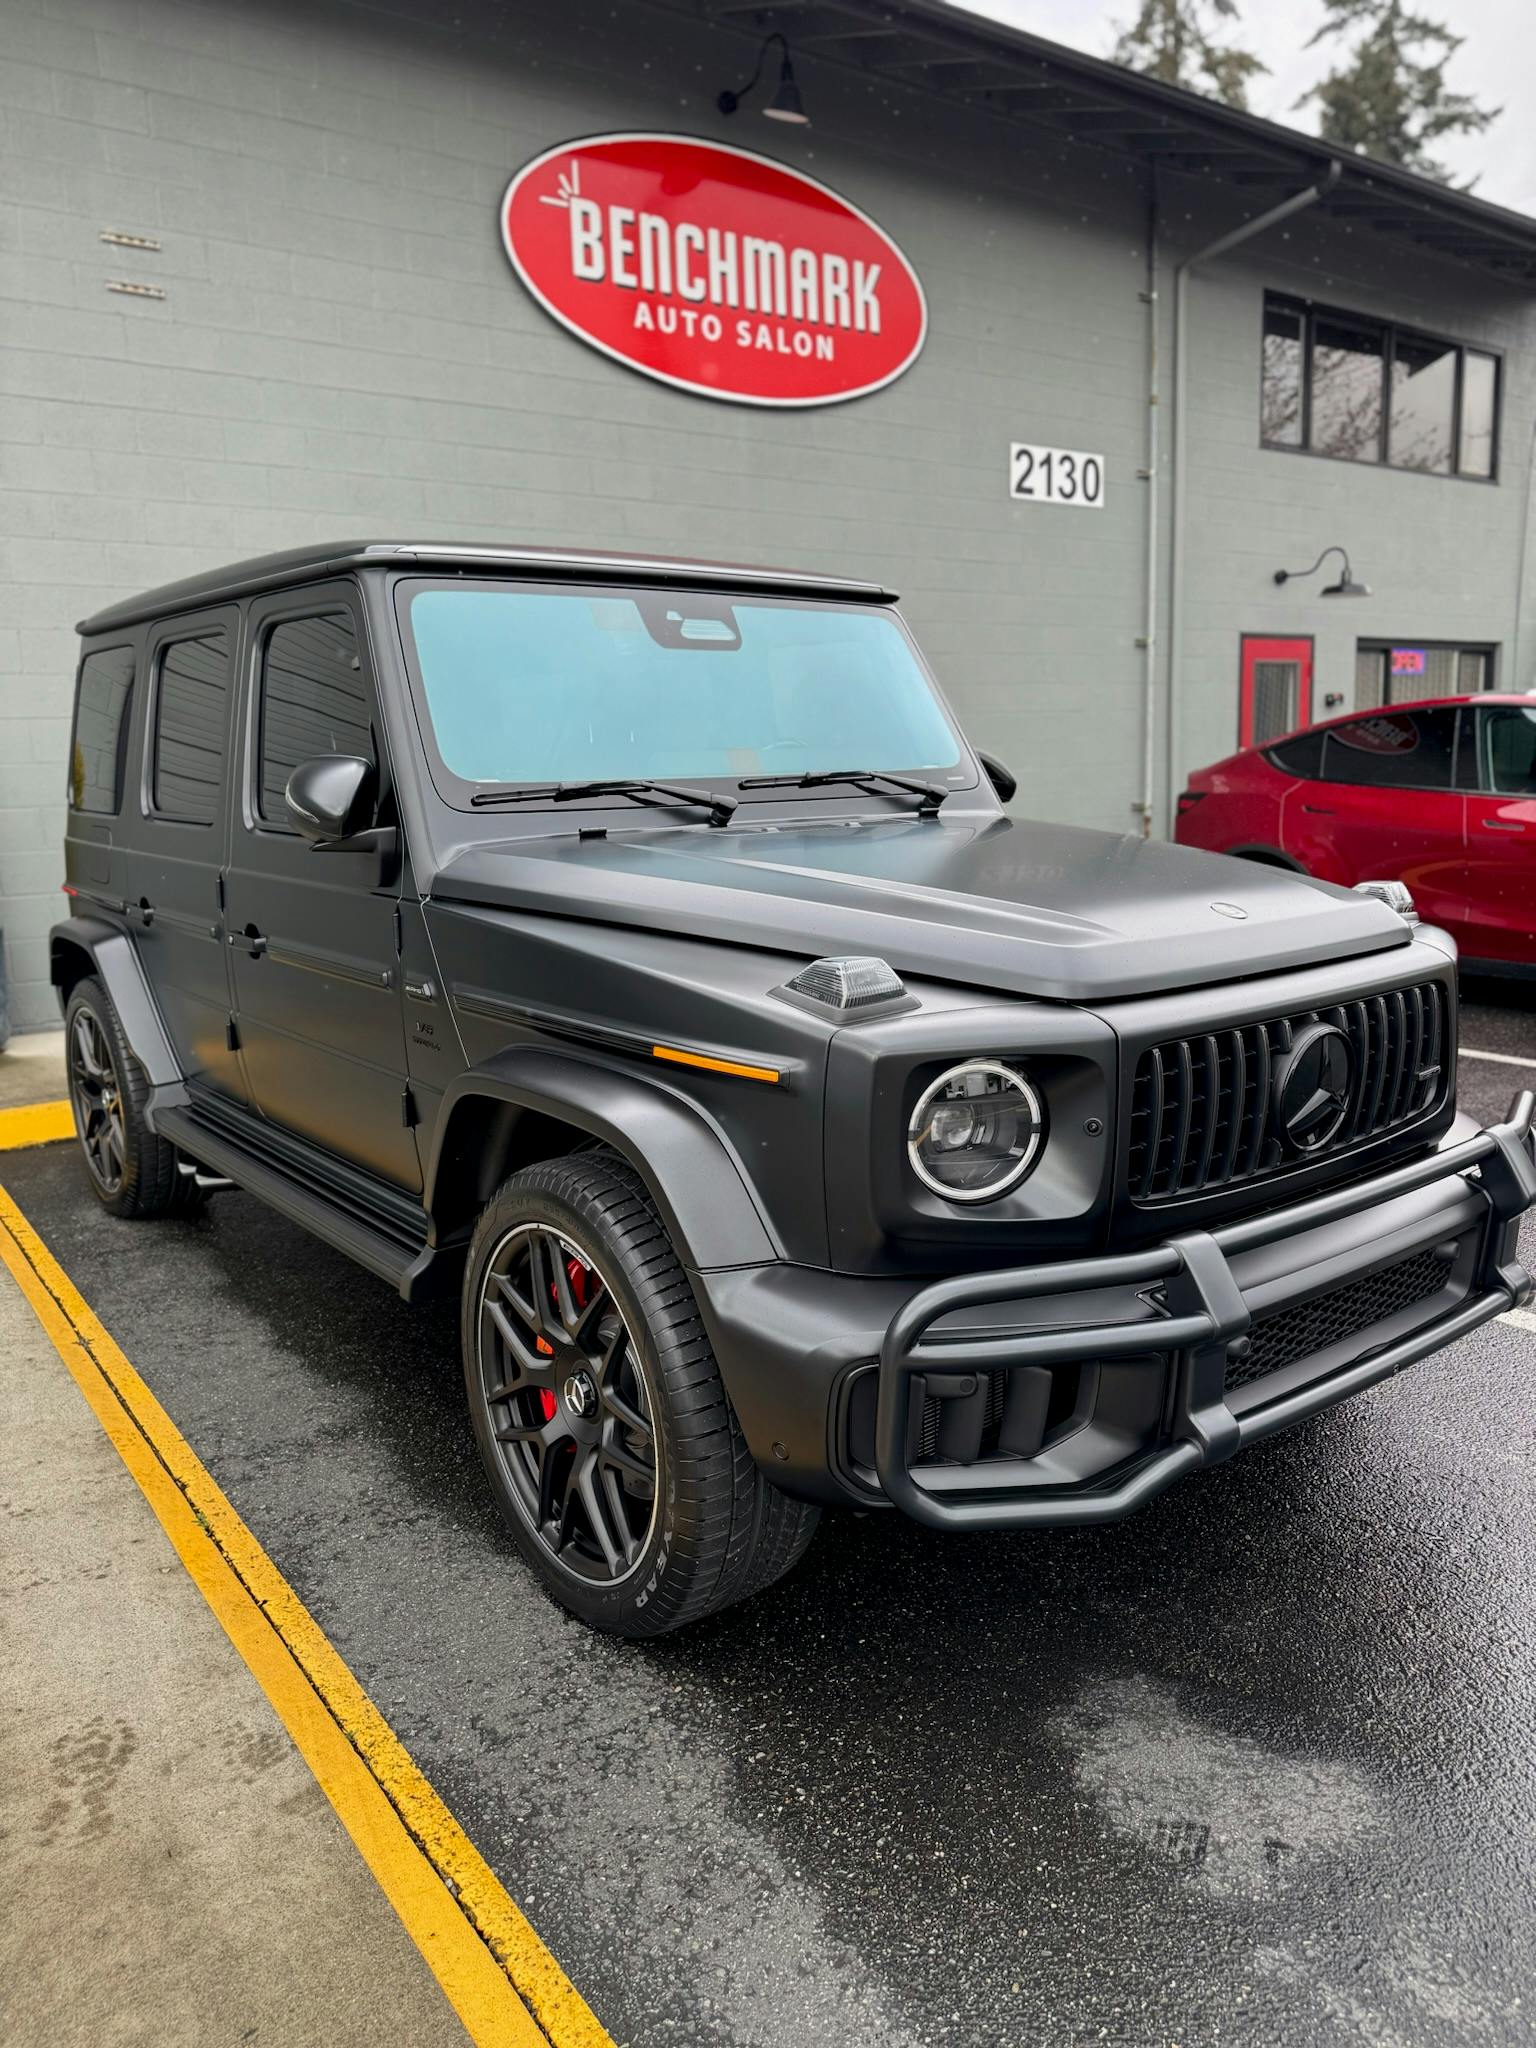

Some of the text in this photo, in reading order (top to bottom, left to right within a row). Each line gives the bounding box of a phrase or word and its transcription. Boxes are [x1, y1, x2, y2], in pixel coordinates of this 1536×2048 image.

[570, 197, 881, 334] BENCHMARK
[634, 302, 834, 361] AUTO SALON
[1015, 449, 1100, 503] 2130
